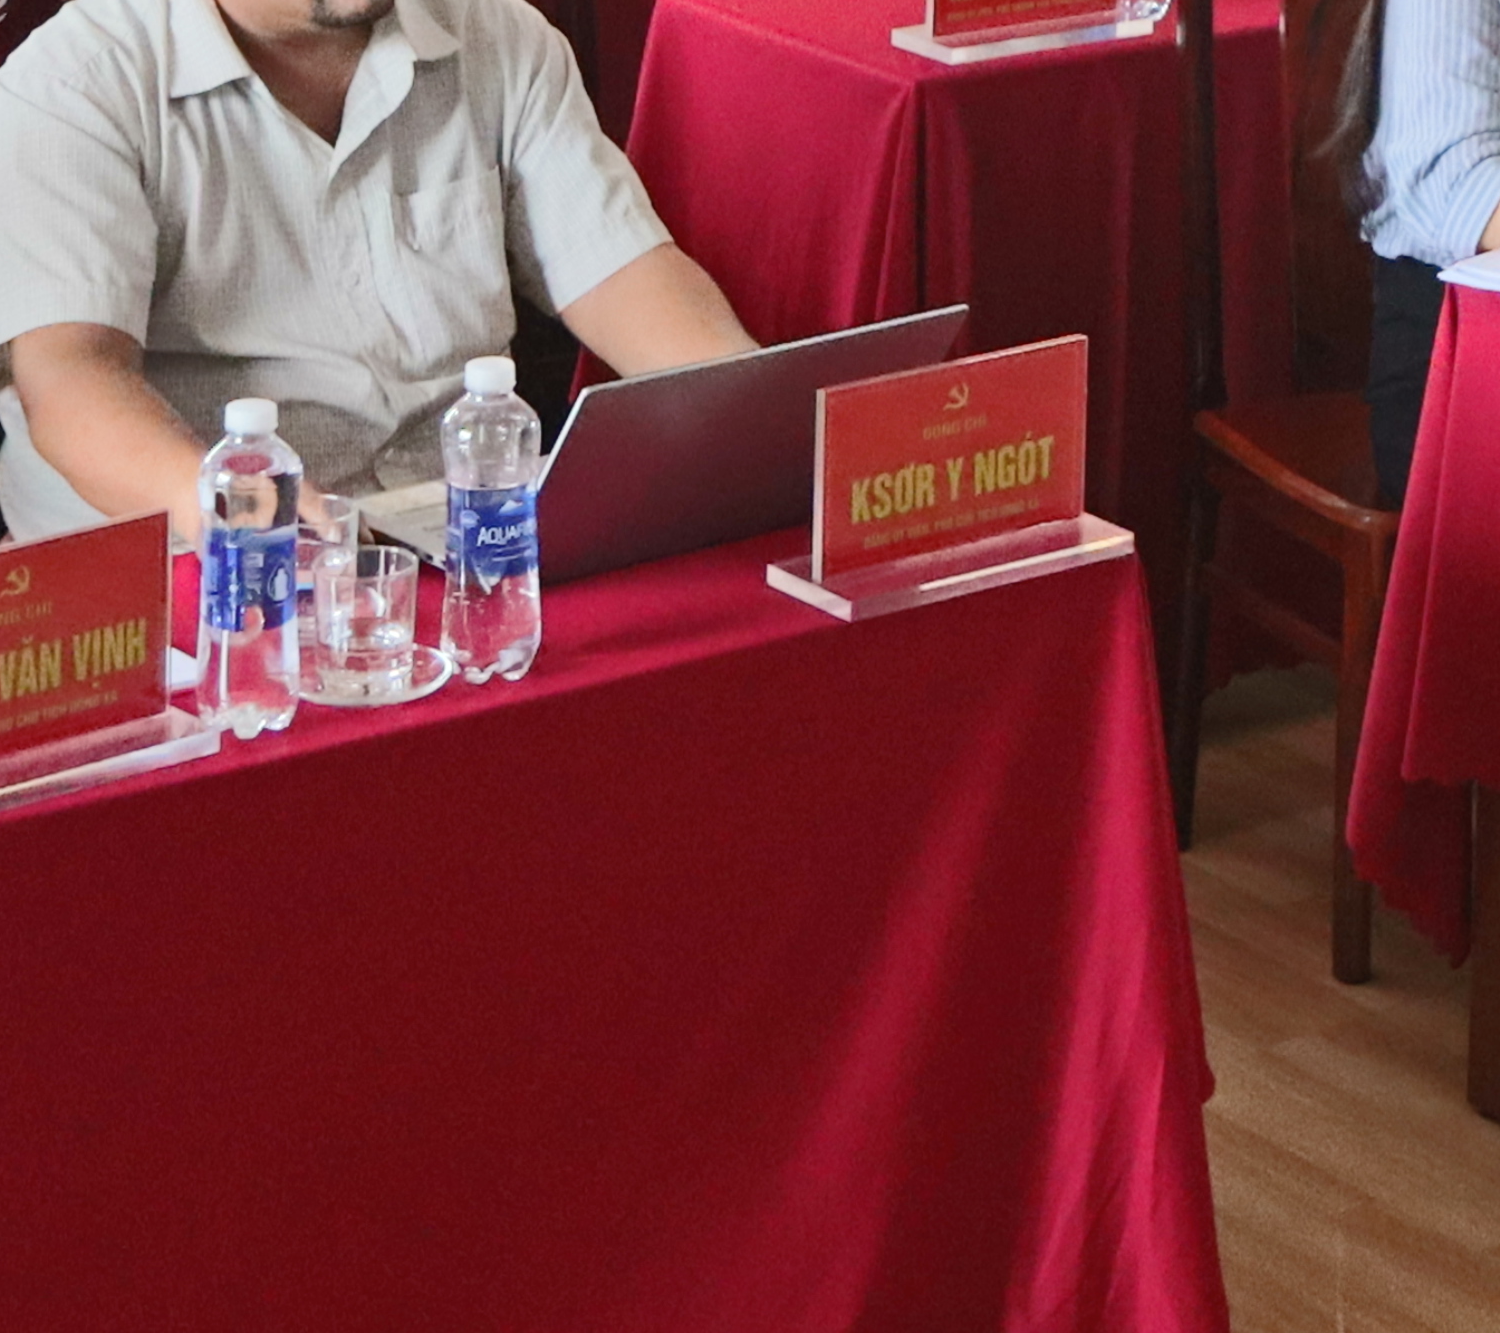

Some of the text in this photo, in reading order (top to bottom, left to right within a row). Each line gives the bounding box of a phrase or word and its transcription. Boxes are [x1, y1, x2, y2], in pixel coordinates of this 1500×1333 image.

[851, 430, 1055, 524] KSƠR Y NGÓT
[72, 617, 148, 689] VỊNH
